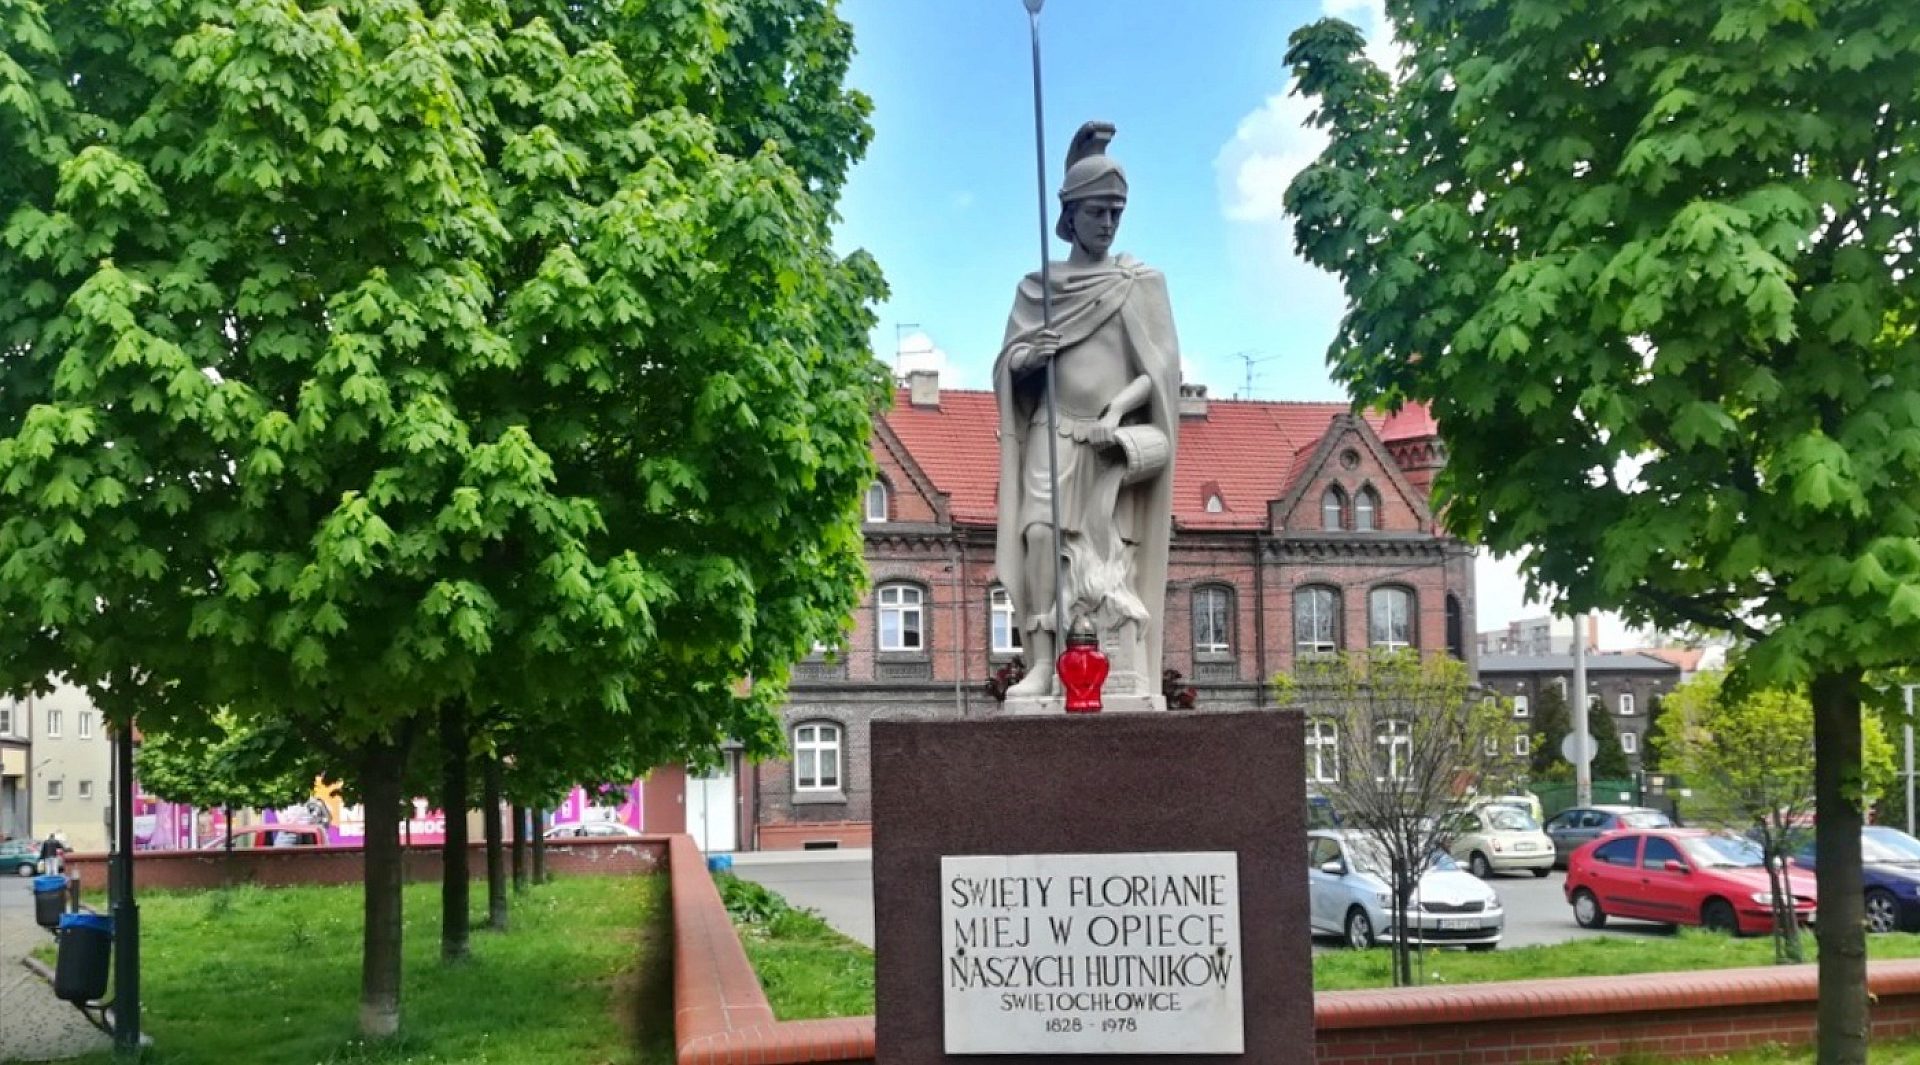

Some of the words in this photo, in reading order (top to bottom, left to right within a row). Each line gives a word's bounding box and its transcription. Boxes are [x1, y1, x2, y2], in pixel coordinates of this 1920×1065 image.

[1070, 875, 1227, 907] FLORIANIE
[955, 915, 1029, 948] MIEJ
[1048, 915, 1072, 946] W
[1087, 913, 1227, 947] OPIECE
[950, 955, 1074, 988] NASZYCH
[1046, 1017, 1082, 1032] 1828
[1102, 1016, 1137, 1033] 1978
